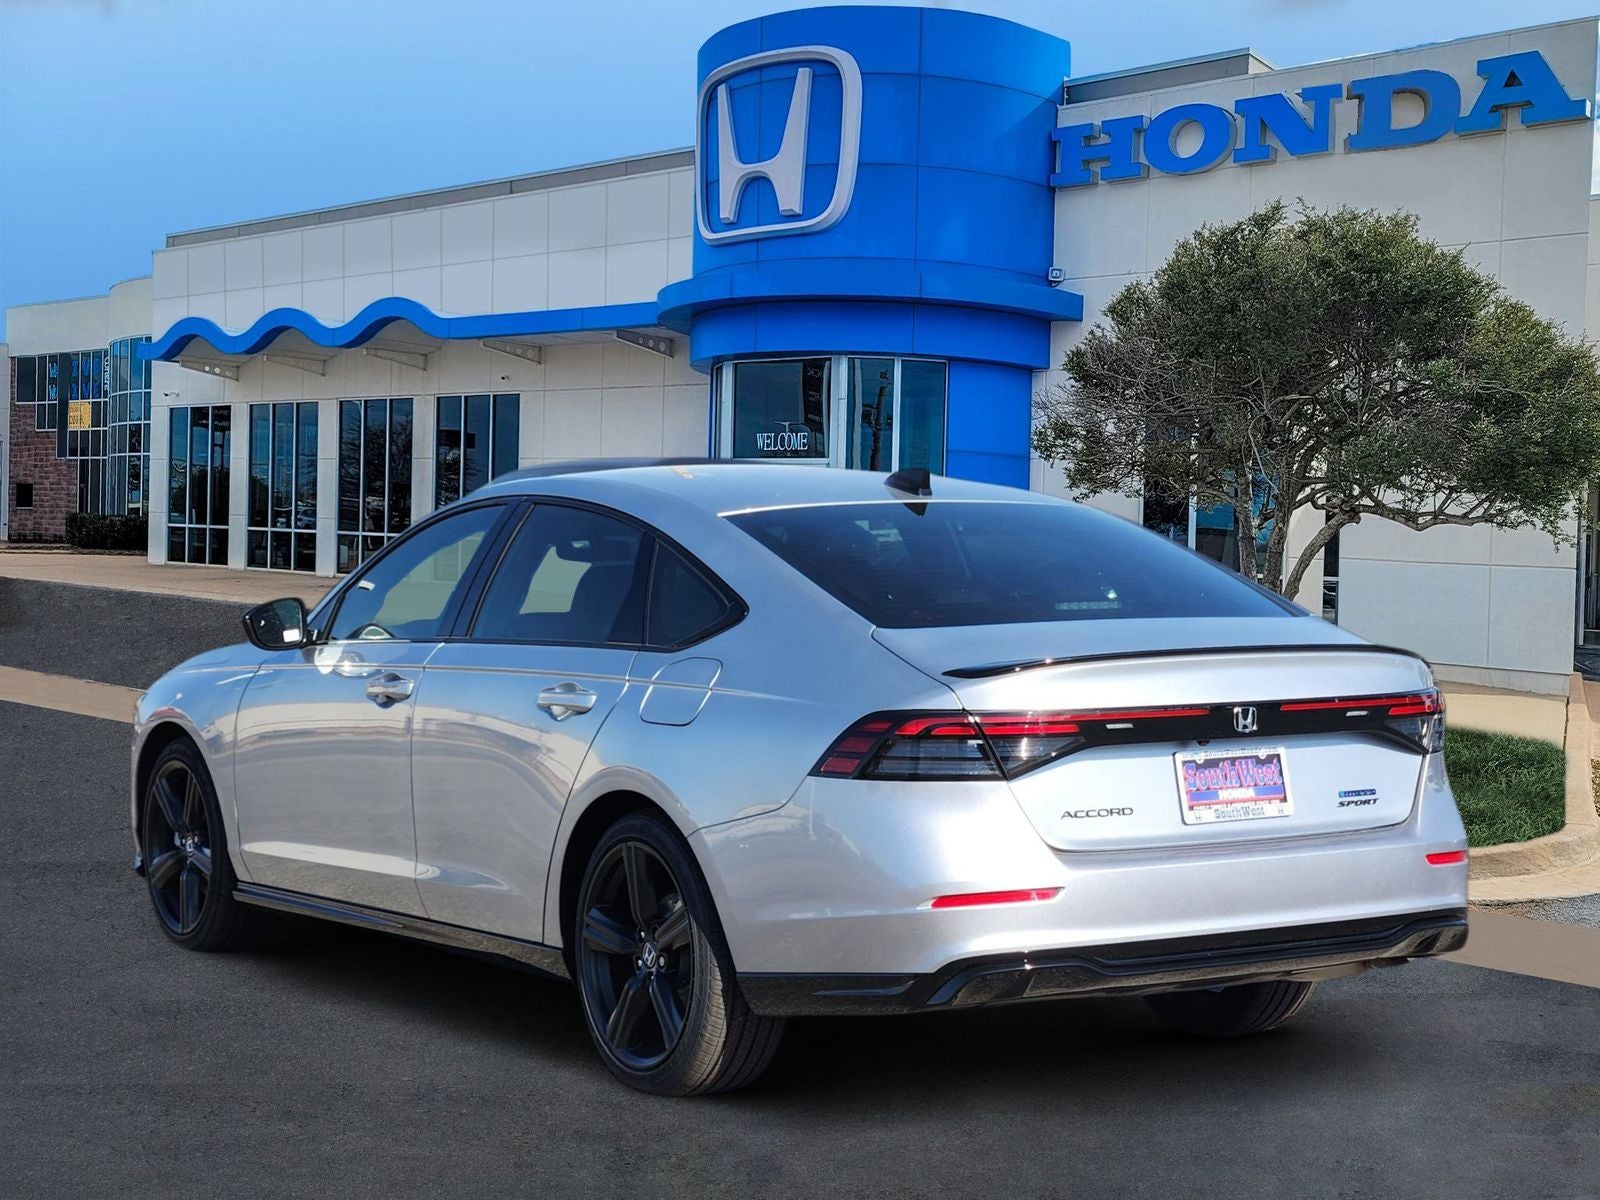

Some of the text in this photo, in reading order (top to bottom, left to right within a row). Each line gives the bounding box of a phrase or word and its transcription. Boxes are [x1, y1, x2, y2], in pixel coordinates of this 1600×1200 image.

[1050, 51, 1591, 188] HONDA
[756, 432, 809, 451] WELCOME
[1184, 758, 1282, 791] SouthWest
[1336, 798, 1380, 808] SPORT
[1060, 808, 1134, 819] ACCORD
[1214, 805, 1266, 819] SouthWest
